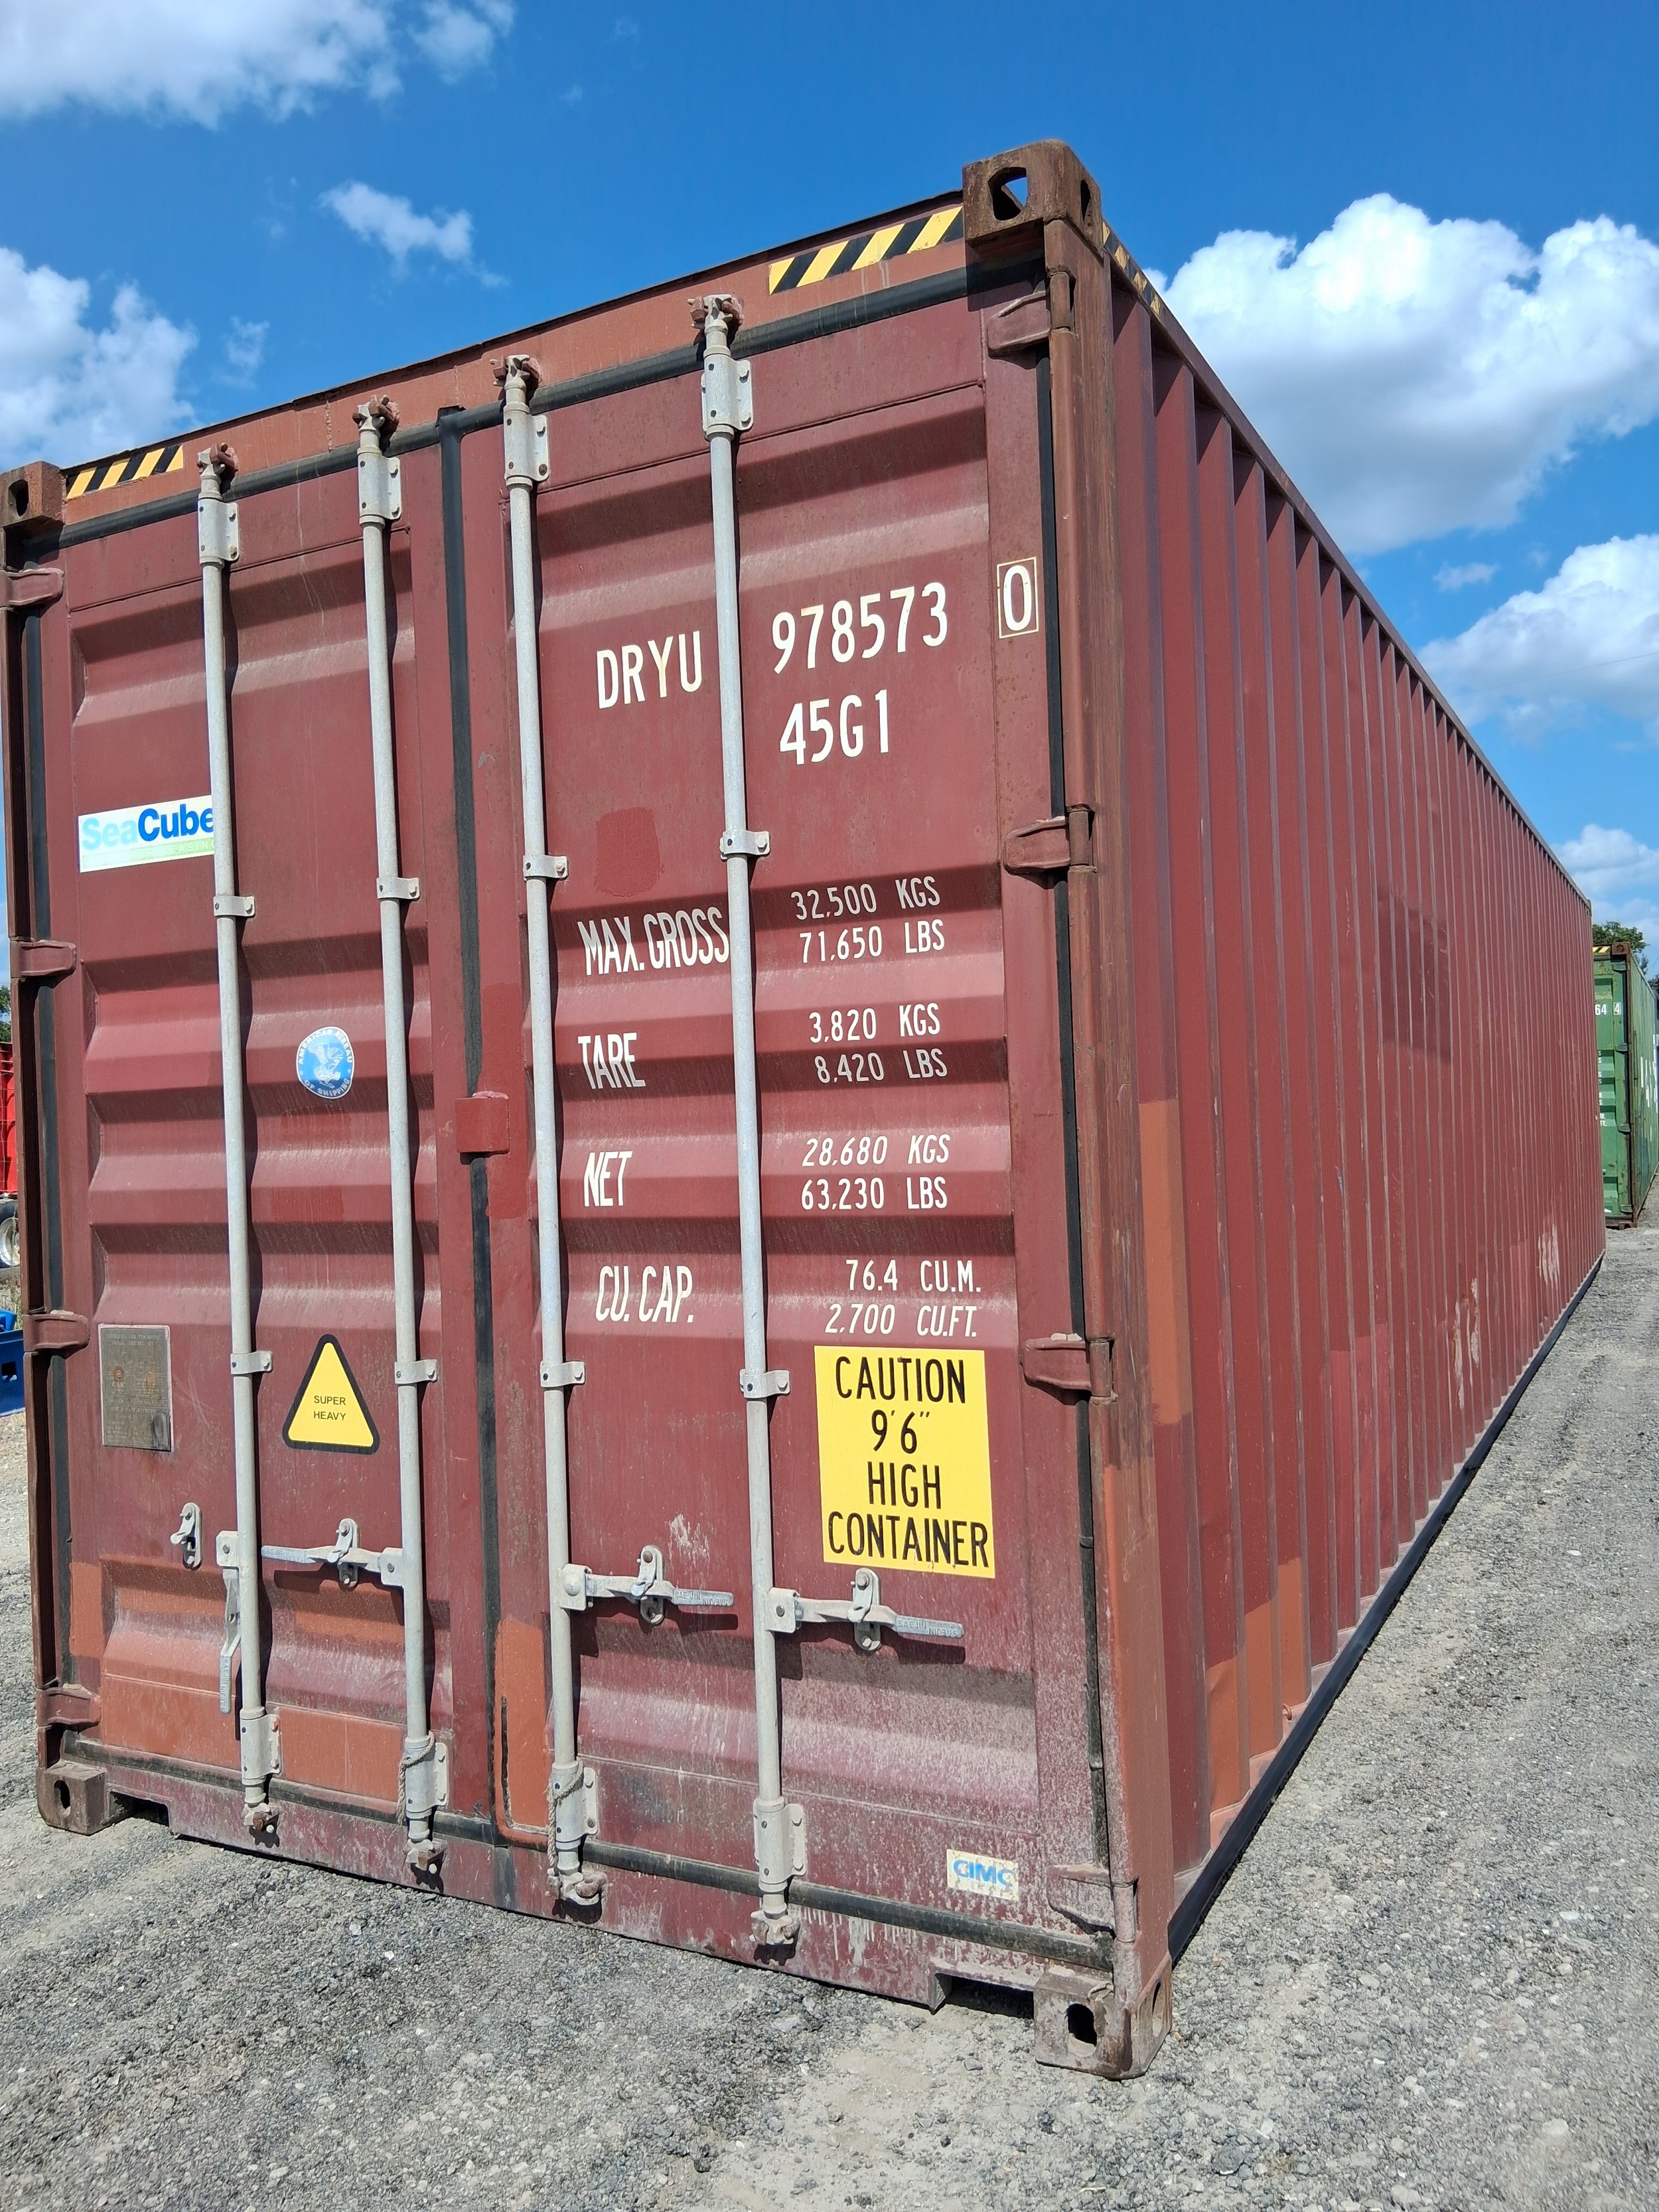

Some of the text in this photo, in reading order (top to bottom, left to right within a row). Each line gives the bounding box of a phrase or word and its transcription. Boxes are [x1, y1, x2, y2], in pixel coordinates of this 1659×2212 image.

[597, 564, 1032, 709] DRYU 978573 0
[779, 689, 889, 765] 45G1
[82, 803, 214, 851] SeaCube
[790, 875, 940, 920] 32,500 KGS
[642, 907, 729, 970] GROSS
[799, 919, 945, 964] 71,650 LBS
[808, 1002, 940, 1043] 3,820 KGS
[299, 1029, 333, 1065] AMERICAN
[334, 1030, 353, 1063] BUREAU
[577, 1031, 646, 1090] TARE
[814, 1048, 948, 1083] 8,420 LBS
[304, 1078, 350, 1096] OF SHIPPING
[802, 1134, 951, 1167] 28,680 KGS
[583, 1151, 633, 1207] NET
[801, 1176, 948, 1210] 63,230 LBS
[638, 1265, 694, 1323] CAP.
[845, 1259, 981, 1292] 76.4 CU.M.
[825, 1303, 977, 1337] 2,700 CU.FT.
[313, 1395, 346, 1406] SUPER
[835, 1356, 966, 1404] CAUTION
[313, 1410, 346, 1422] HEAVY
[867, 1461, 942, 1510] HIGH
[827, 1511, 990, 1568] CONTAINER
[953, 1859, 1013, 1887] CIMC
